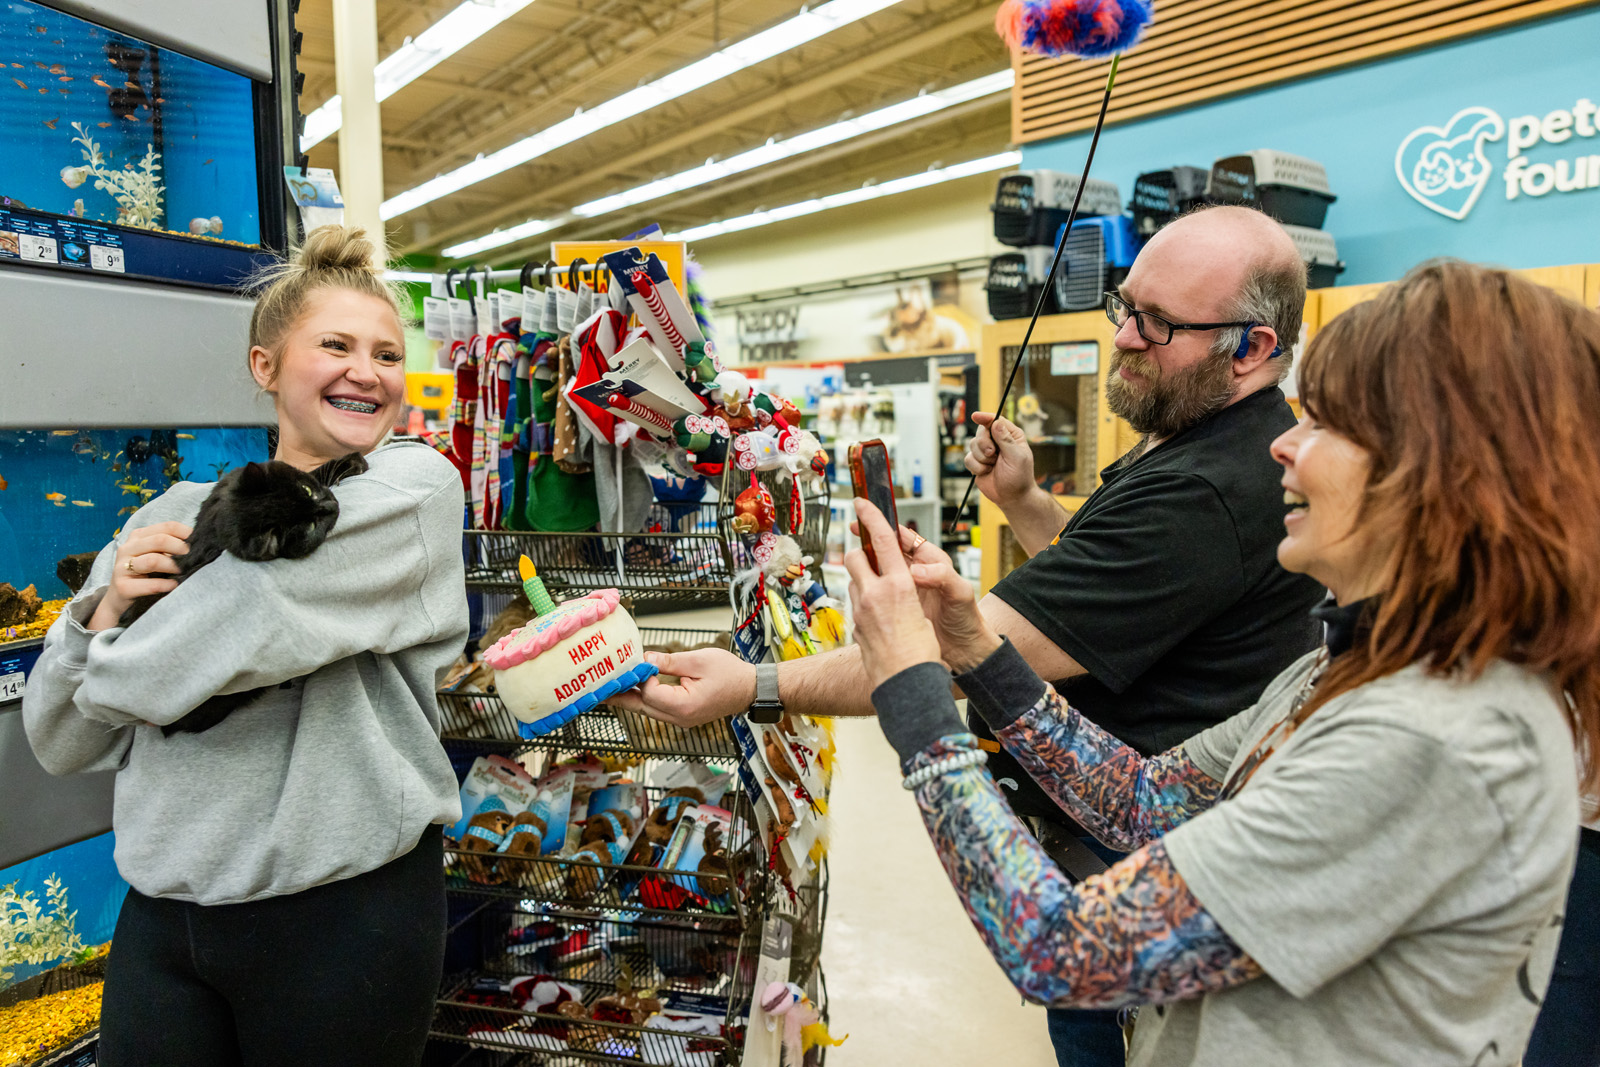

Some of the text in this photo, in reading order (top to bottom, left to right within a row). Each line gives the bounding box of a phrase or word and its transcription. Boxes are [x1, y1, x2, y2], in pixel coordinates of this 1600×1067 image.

[1507, 98, 1600, 159] pet
[619, 358, 640, 374] MERRY
[568, 630, 607, 665] HAPPY
[553, 655, 615, 702] ADOPTION
